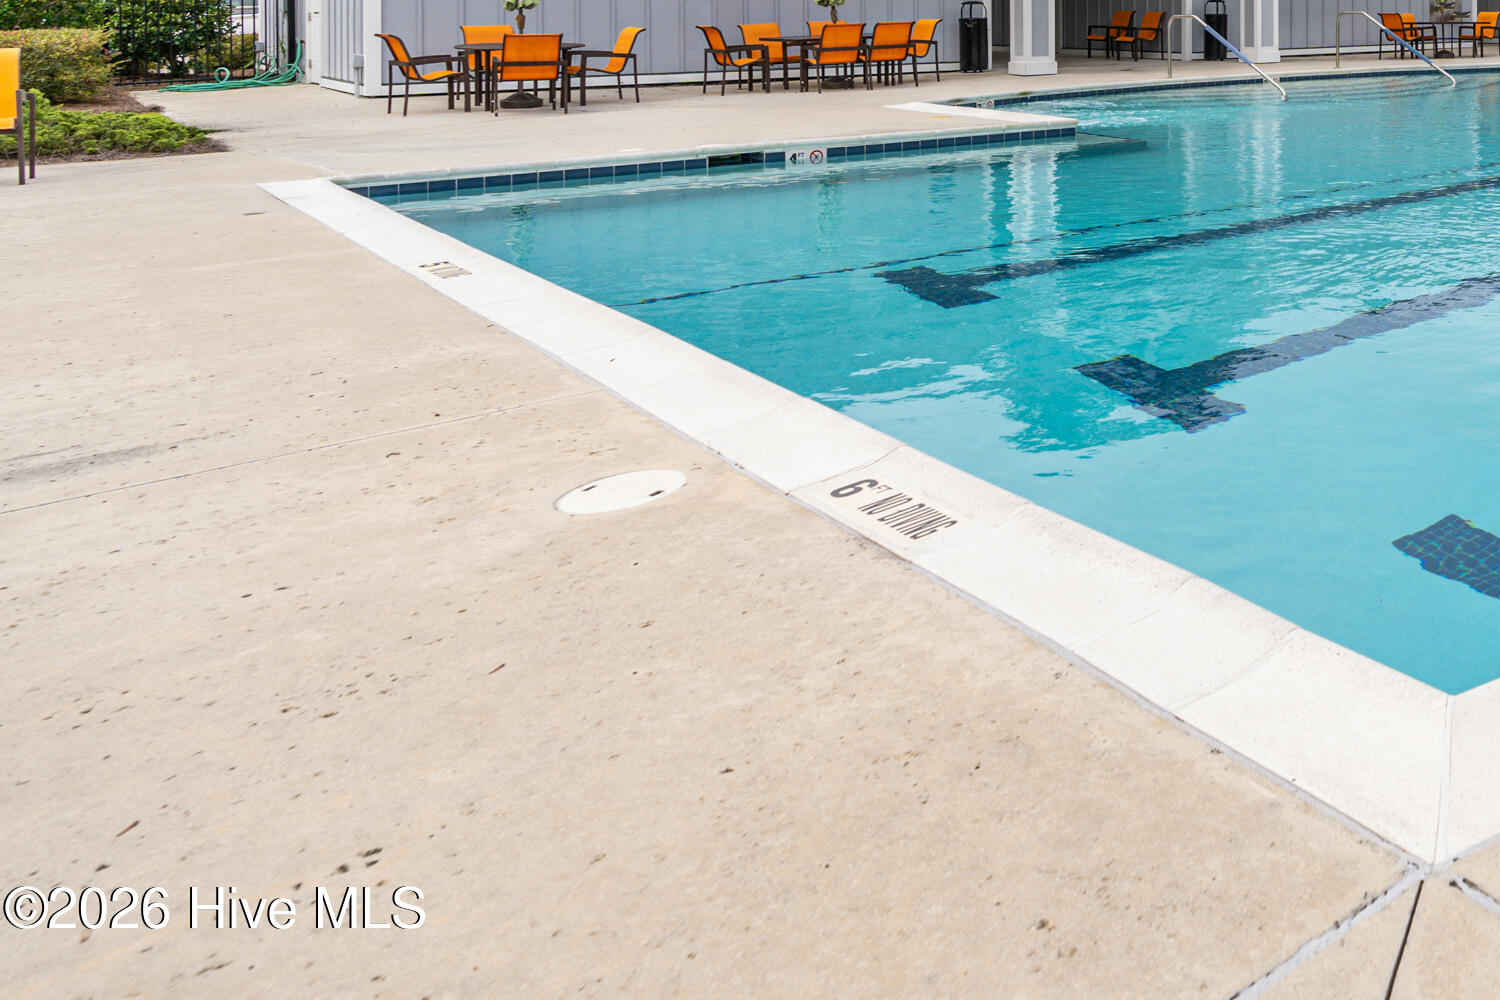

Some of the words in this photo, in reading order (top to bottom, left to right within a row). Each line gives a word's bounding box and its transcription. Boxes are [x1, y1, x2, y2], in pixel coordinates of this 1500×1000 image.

[830, 479, 879, 498] 6
[872, 484, 893, 495] FT
[857, 492, 913, 515] NO
[877, 502, 958, 540] DIVING
